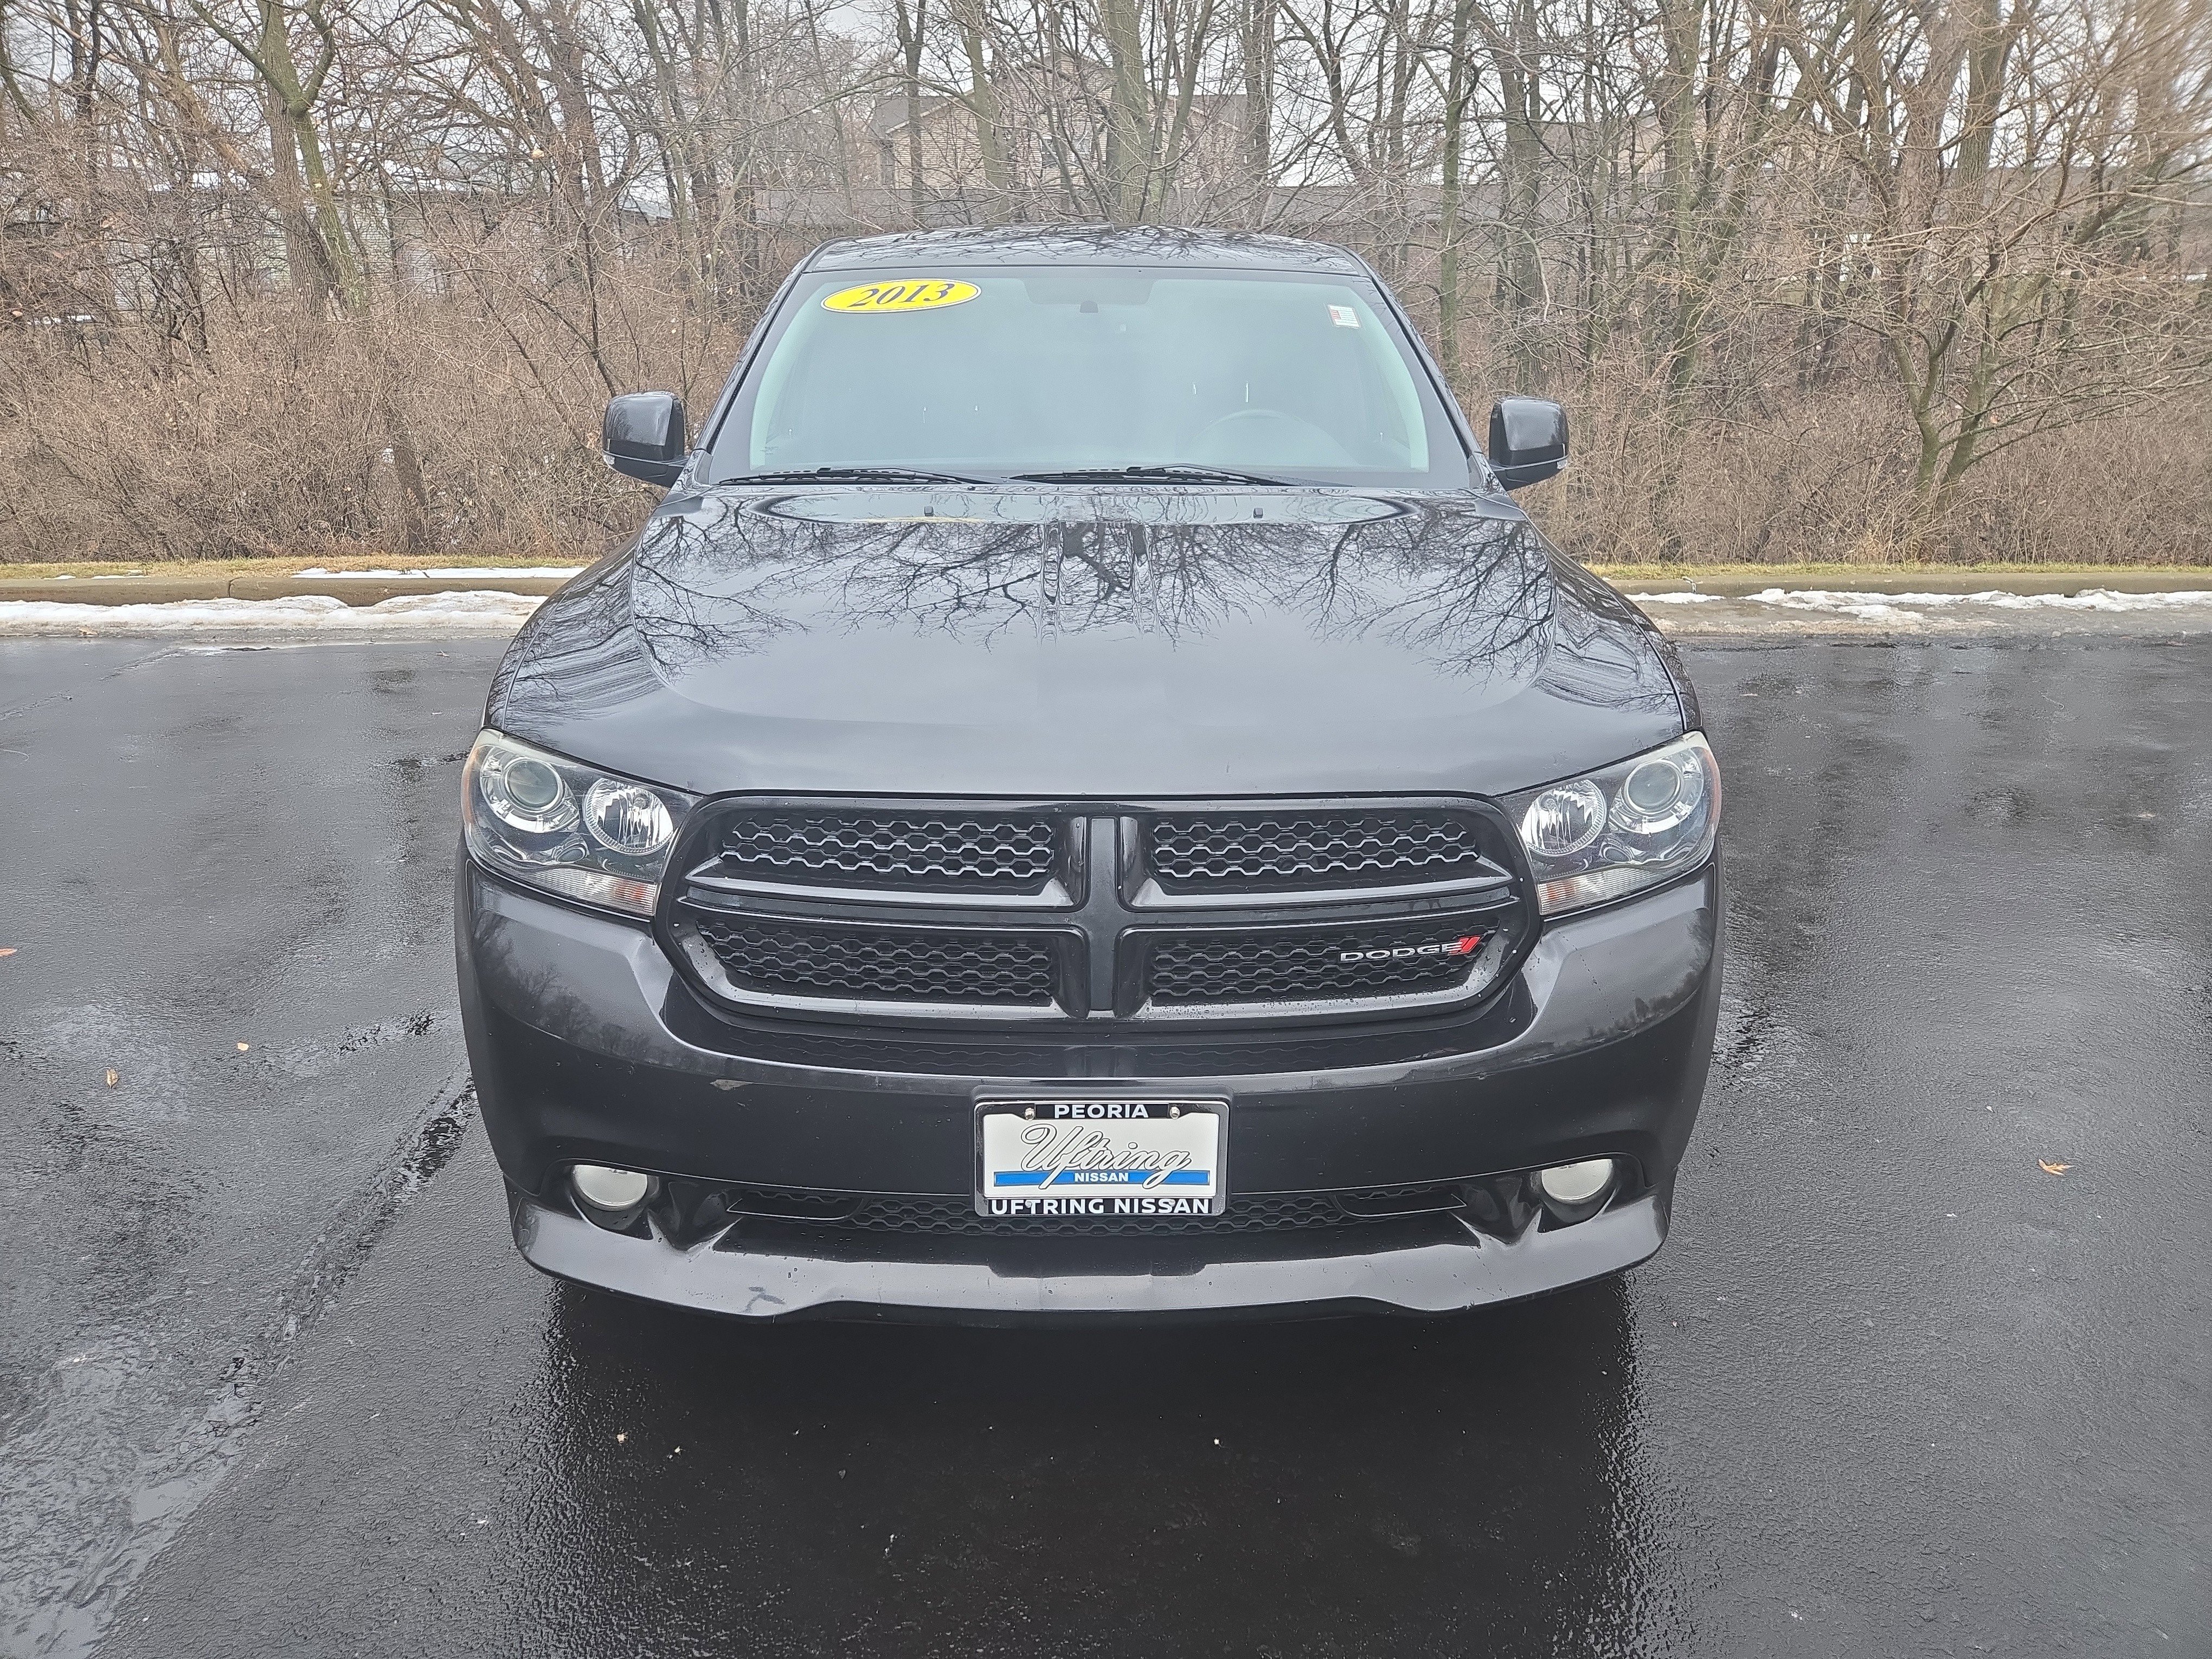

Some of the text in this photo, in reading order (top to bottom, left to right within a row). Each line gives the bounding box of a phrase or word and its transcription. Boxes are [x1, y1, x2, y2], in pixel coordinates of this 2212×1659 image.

[847, 284, 954, 307] 2013
[1340, 942, 1463, 961] DODGE
[1054, 1104, 1149, 1118] PEORIA
[1020, 1124, 1192, 1189] Uftring
[1075, 1172, 1129, 1182] NISSAN
[992, 1199, 1212, 1215] UFTRING NISSAN
